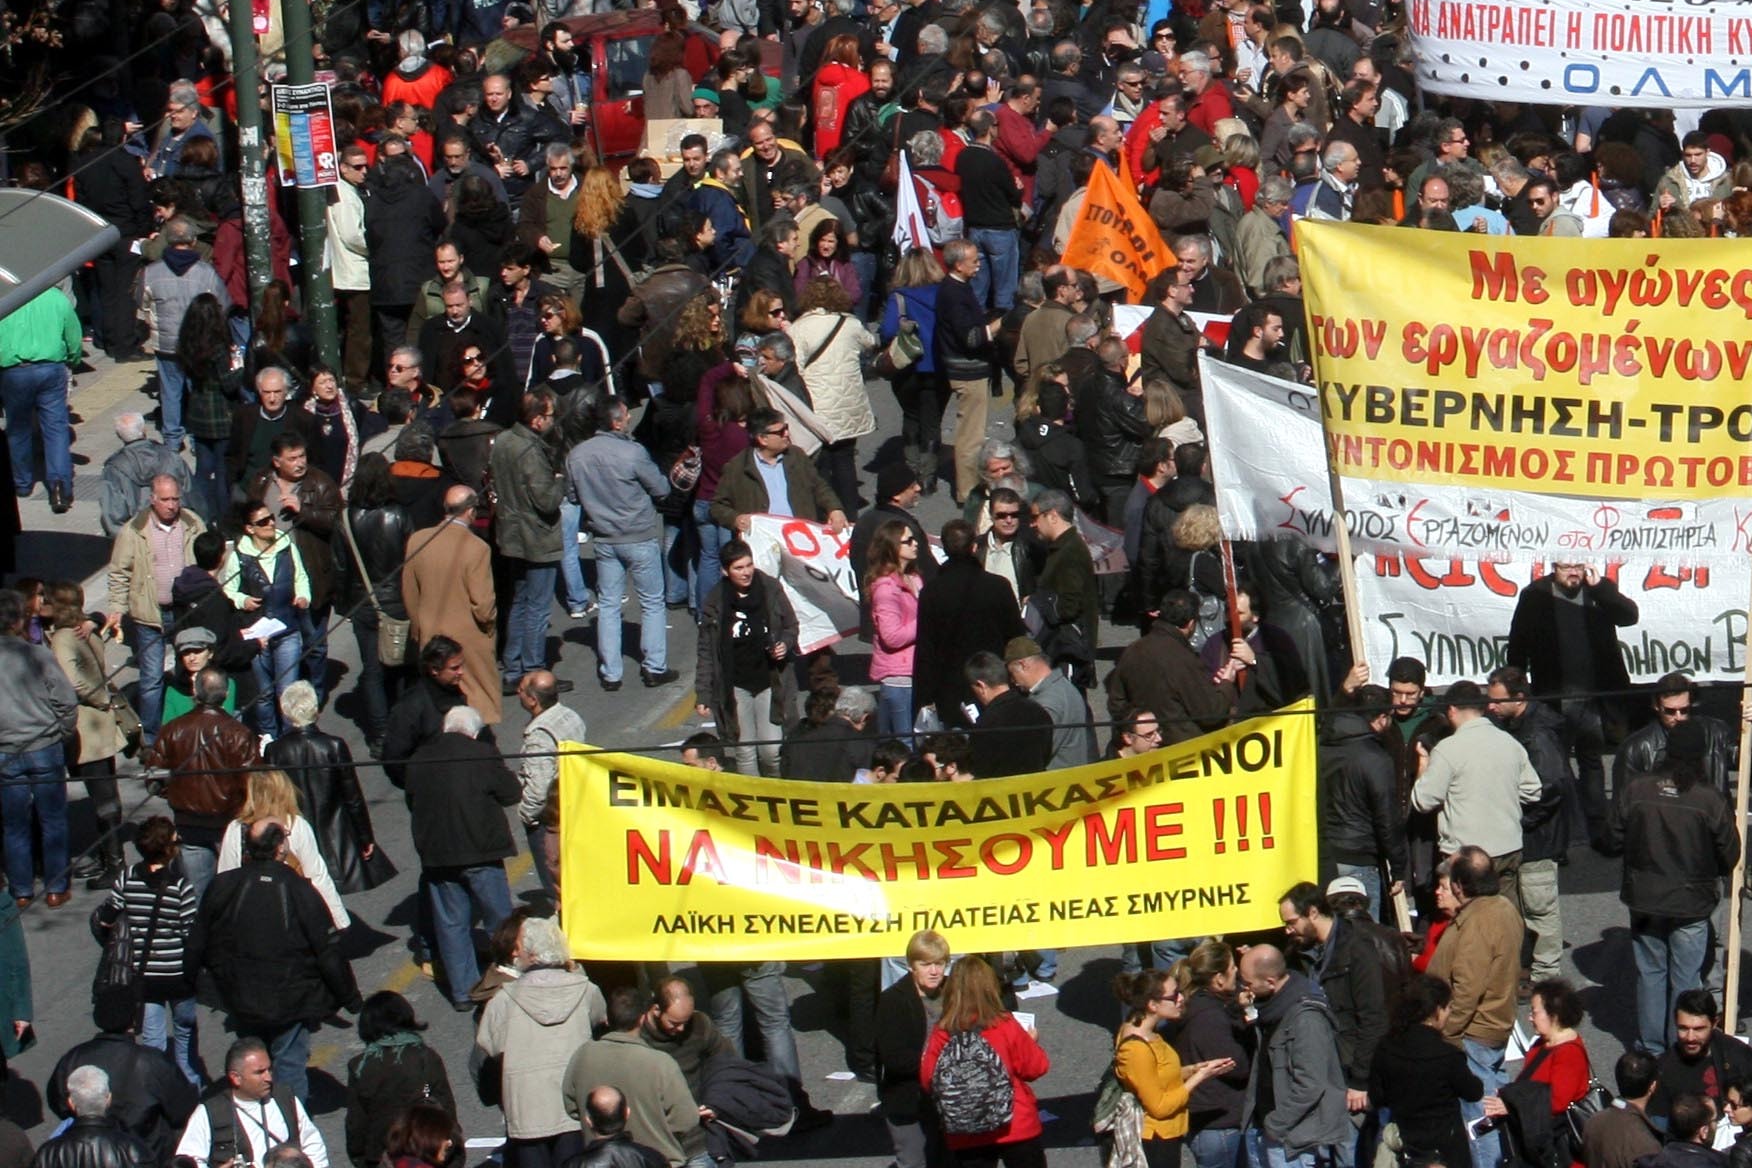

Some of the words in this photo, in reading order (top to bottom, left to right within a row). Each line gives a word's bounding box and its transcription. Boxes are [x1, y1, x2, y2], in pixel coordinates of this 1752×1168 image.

[1437, 0, 1556, 48] ΑΝΑΤΡΑΠΕΙ
[1566, 10, 1583, 50] Η
[1593, 12, 1712, 54] ΠΟΛΙΤΙΚΗ
[1467, 249, 1550, 305] Με
[1556, 530, 1595, 550] στα
[608, 769, 820, 829] ΕΙΜΑΣΤΕ
[838, 729, 1285, 829] ΚΑΤΑΔΙΚΑΣΜΕΝΟΙ
[625, 827, 728, 886] ΝΑ
[754, 802, 1188, 885] ΝΙΚΗΣΟΥΜΕ
[1211, 792, 1276, 855] !!!
[652, 910, 735, 935] ΛΑΪΚΗ
[743, 910, 903, 937] ΣΥΝΕΛΕΥΣΗ
[911, 897, 1041, 934] ΠΛΑΤΕΙΑΣ
[1047, 893, 1121, 922] ΝΕΑΣ
[1125, 881, 1252, 916] ΣΜΥΡΝΗΣ
